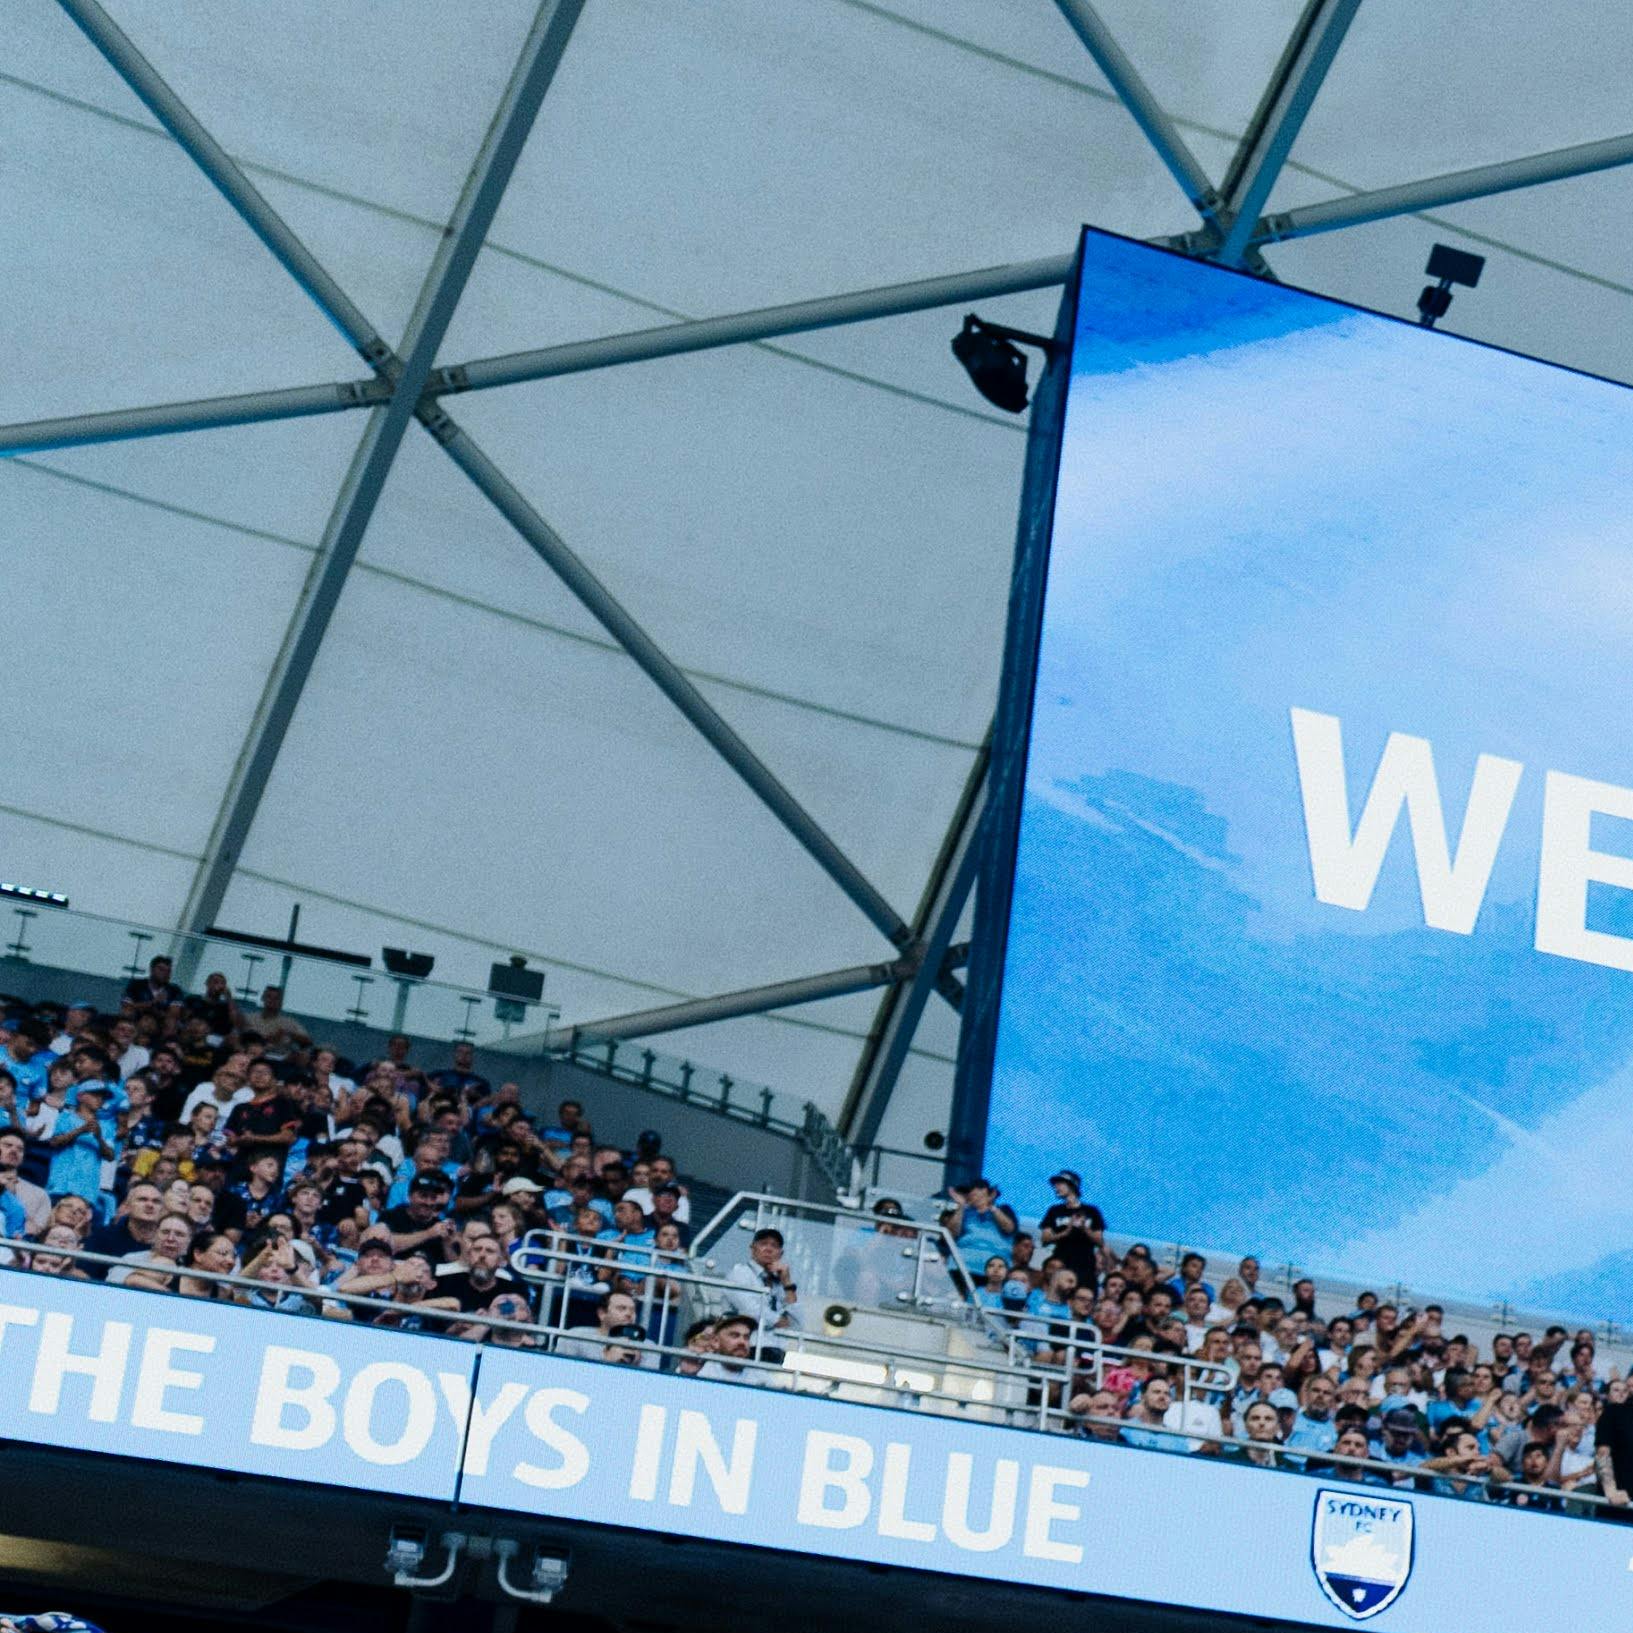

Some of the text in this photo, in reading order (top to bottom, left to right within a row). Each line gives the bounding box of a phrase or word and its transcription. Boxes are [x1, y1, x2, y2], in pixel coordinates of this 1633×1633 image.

[249, 1345, 590, 1489] BOYS
[629, 1403, 758, 1515] IN
[796, 1429, 1090, 1564] BLUE
[1328, 1499, 1402, 1522] SYDNEY
